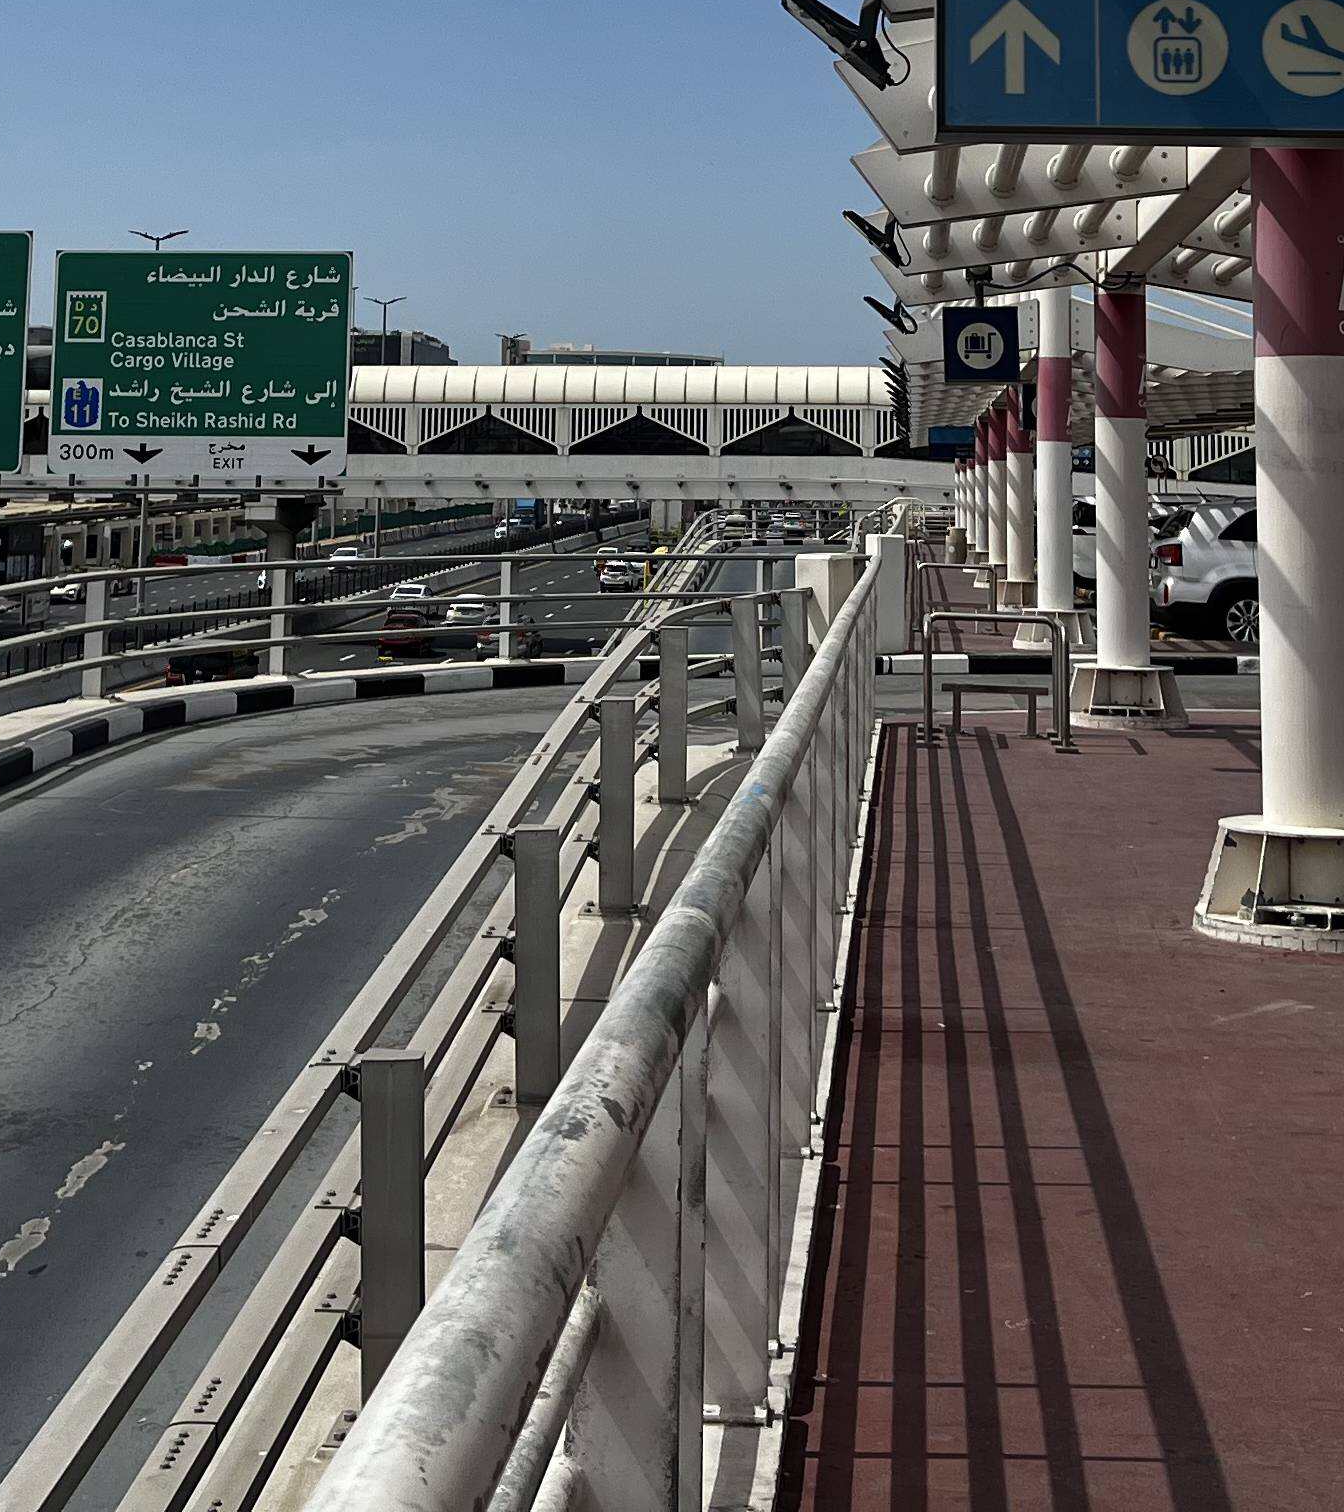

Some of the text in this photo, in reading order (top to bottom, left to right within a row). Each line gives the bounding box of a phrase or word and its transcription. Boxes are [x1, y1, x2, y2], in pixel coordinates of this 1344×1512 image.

[146, 265, 341, 289] شارع الدار البيضاء
[75, 301, 84, 312] D
[212, 298, 340, 322] قرية الشحن
[72, 316, 99, 335] 70
[111, 331, 245, 348] Casablanca St
[110, 351, 235, 371] Cargo Village
[108, 378, 337, 408] إلى شارع الشيخ راشد
[71, 405, 92, 424] 11
[108, 412, 297, 430] To Sheikh Rashid Rd
[59, 443, 114, 461] 300m
[208, 441, 246, 455] مخرج
[212, 457, 245, 470] EXIT
